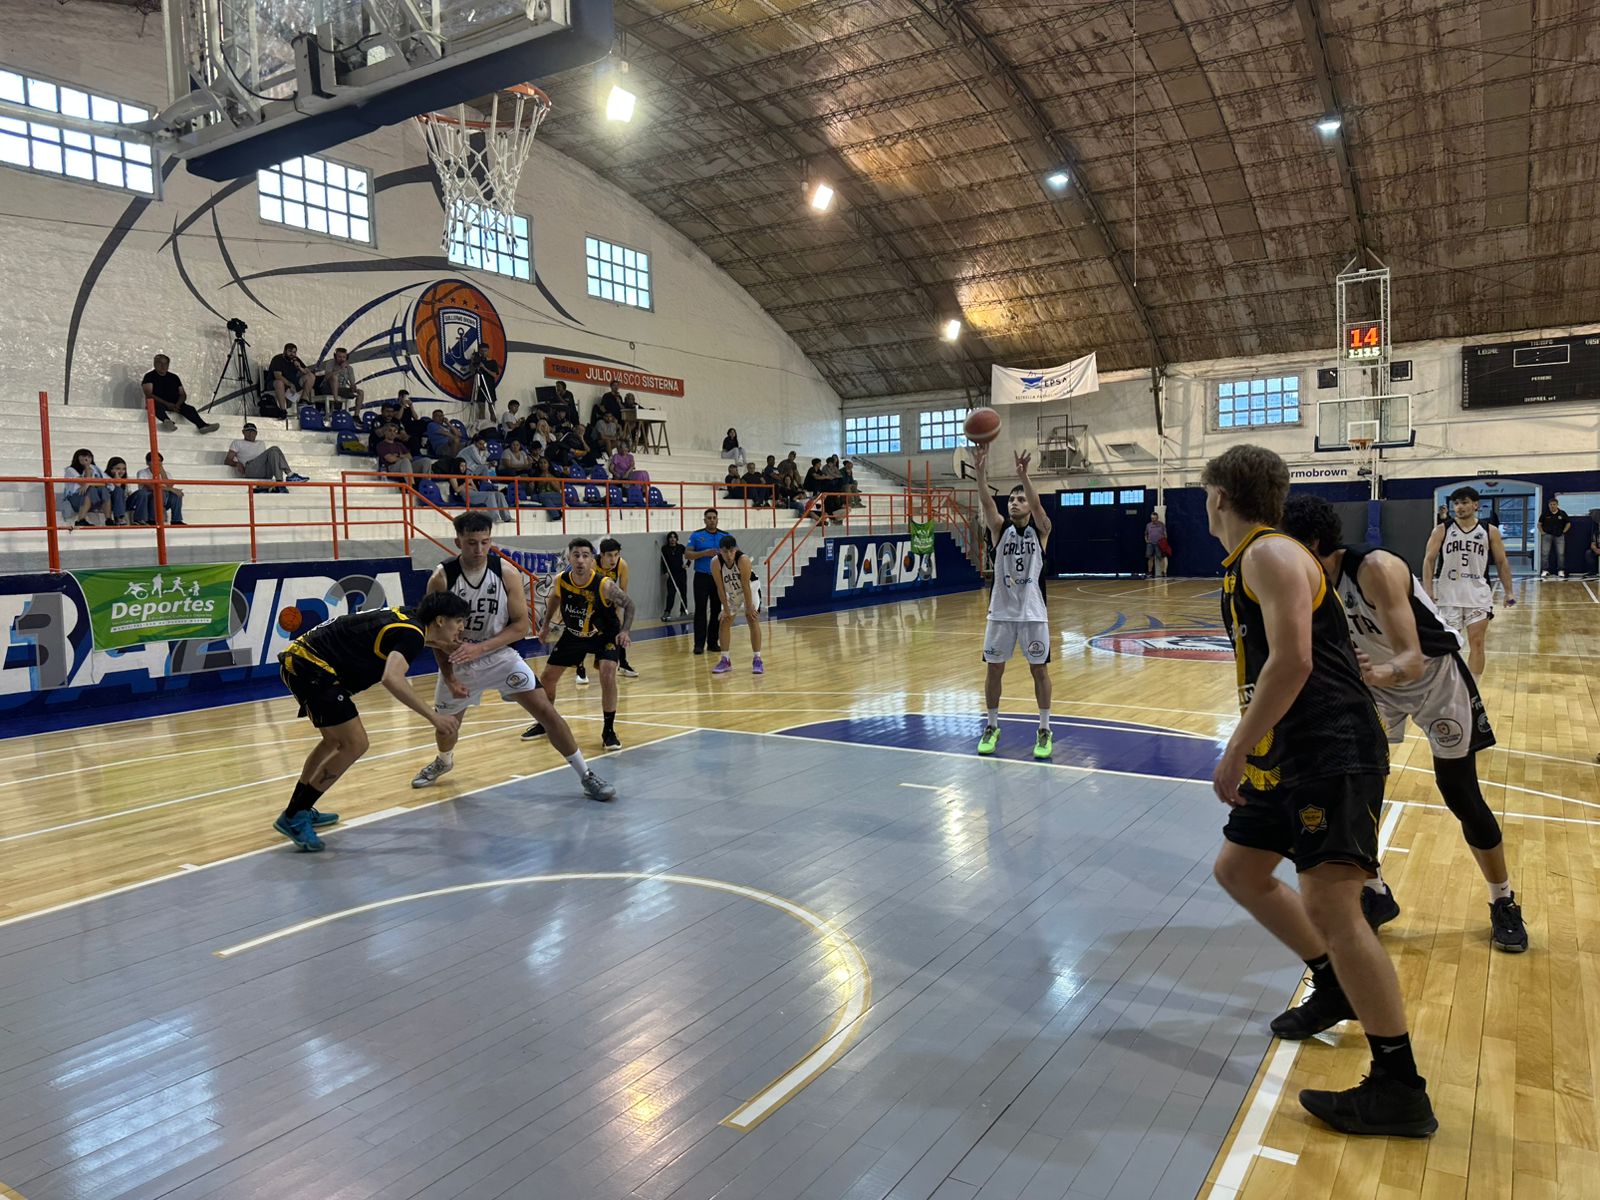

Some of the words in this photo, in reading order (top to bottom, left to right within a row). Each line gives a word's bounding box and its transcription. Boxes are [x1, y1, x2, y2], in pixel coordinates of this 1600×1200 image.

[1350, 327, 1379, 348] 14
[1348, 346, 1380, 359] 1:13.5
[552, 363, 579, 375] TRIBUNA
[585, 367, 612, 382] JULIO
[613, 371, 640, 386] VASCO
[641, 375, 679, 391] SISTERNA
[1044, 377, 1067, 388] EPSA
[1446, 540, 1484, 556] CALETA
[1015, 557, 1025, 572] 8
[1462, 553, 1469, 567] 5
[111, 597, 215, 622] Deportes
[468, 598, 499, 616] LETA
[464, 615, 484, 632] 15
